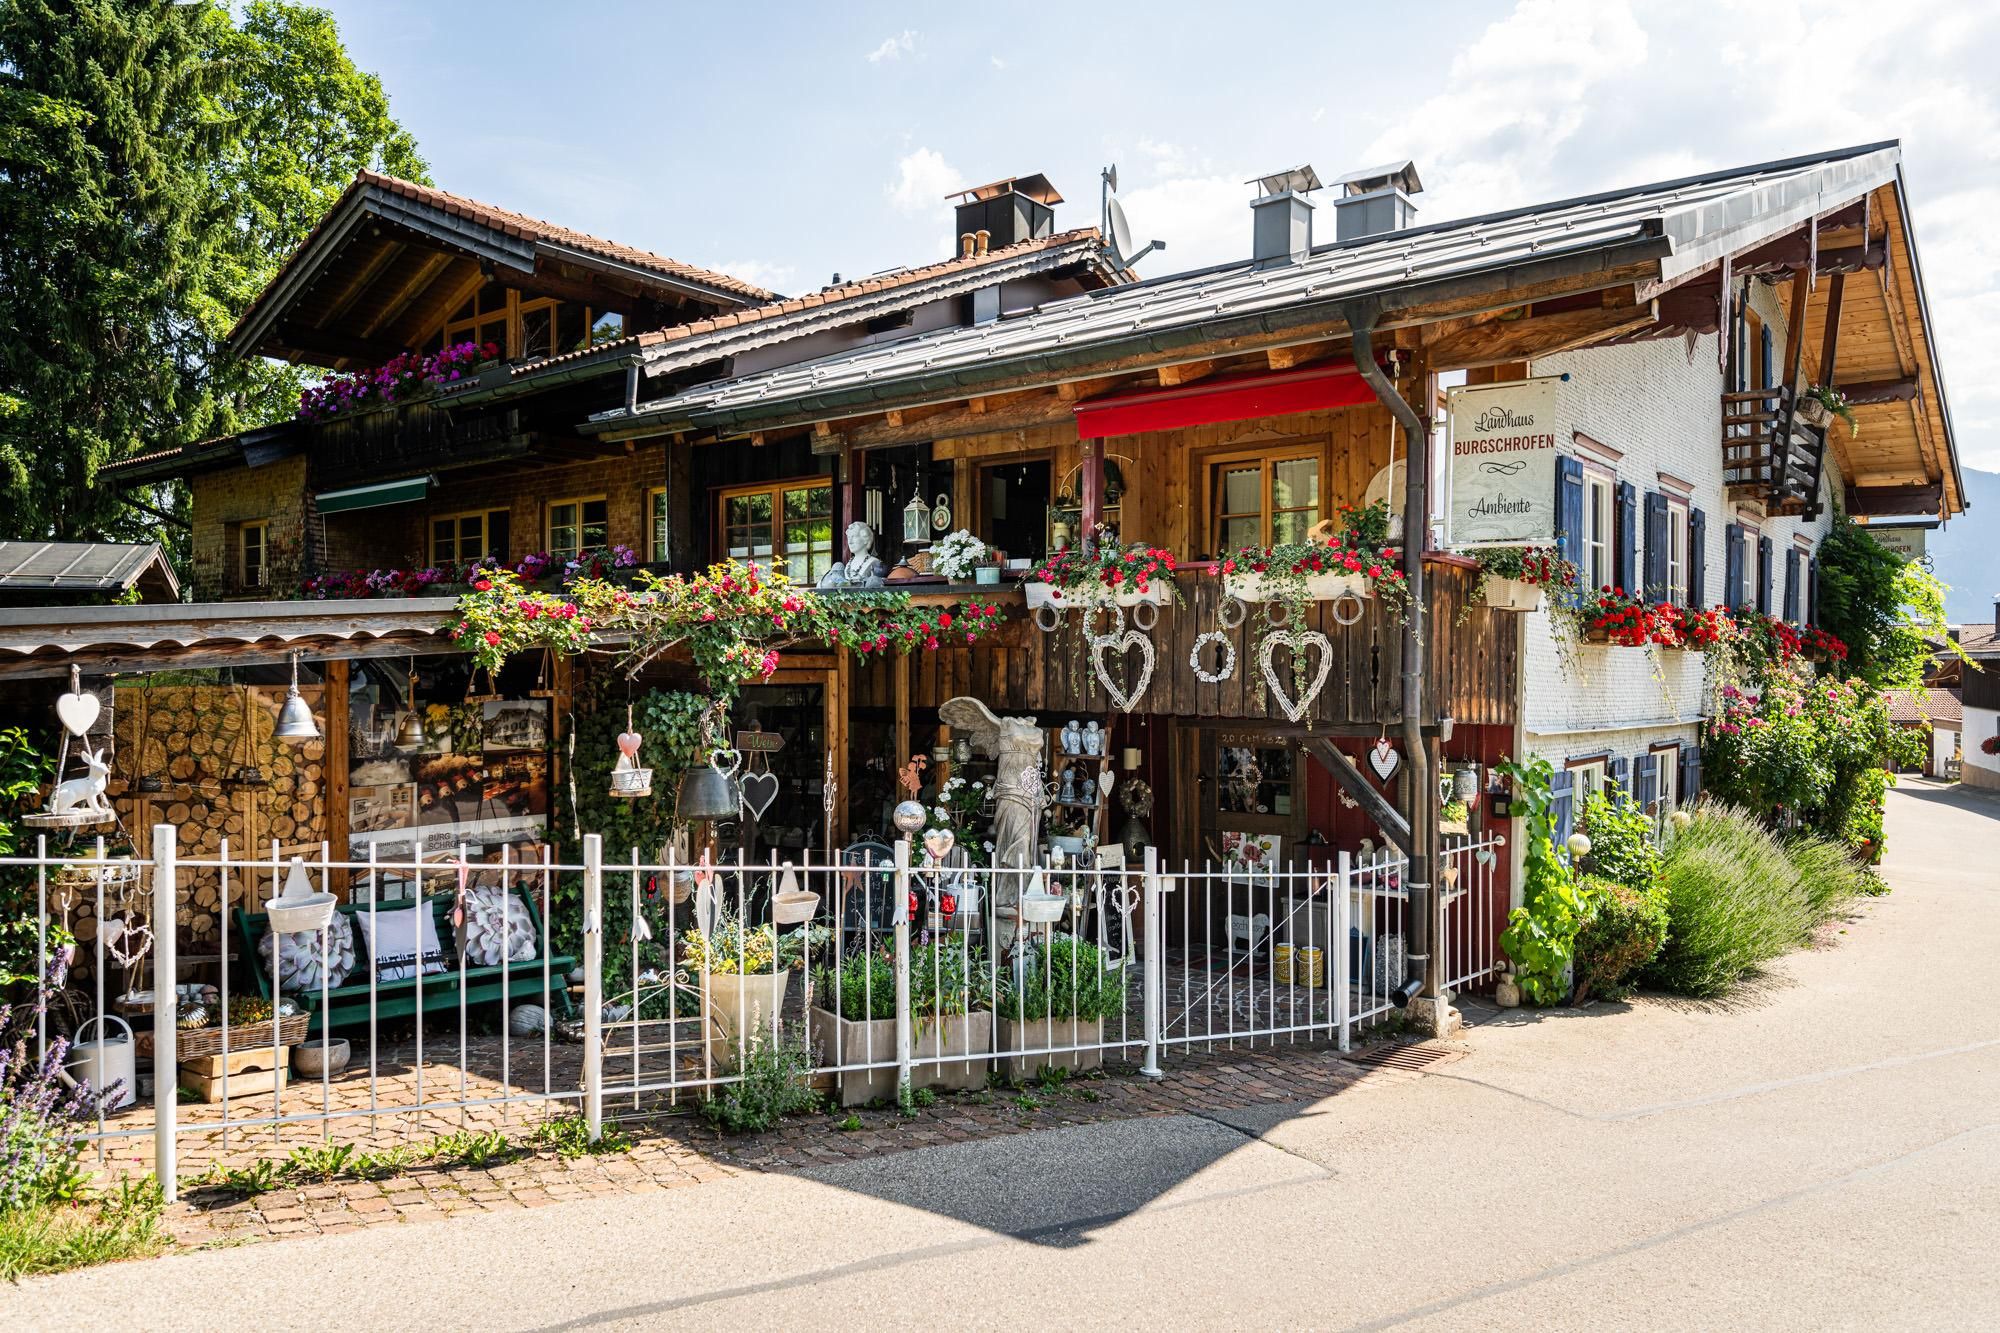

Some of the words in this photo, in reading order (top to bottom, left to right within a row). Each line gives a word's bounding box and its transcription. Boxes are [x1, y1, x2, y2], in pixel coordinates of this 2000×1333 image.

[1475, 406, 1534, 432] Landhaus
[1454, 434, 1554, 456] BURGSCHROFEN
[1468, 492, 1532, 518] Ambiente
[428, 832, 451, 842] BURG
